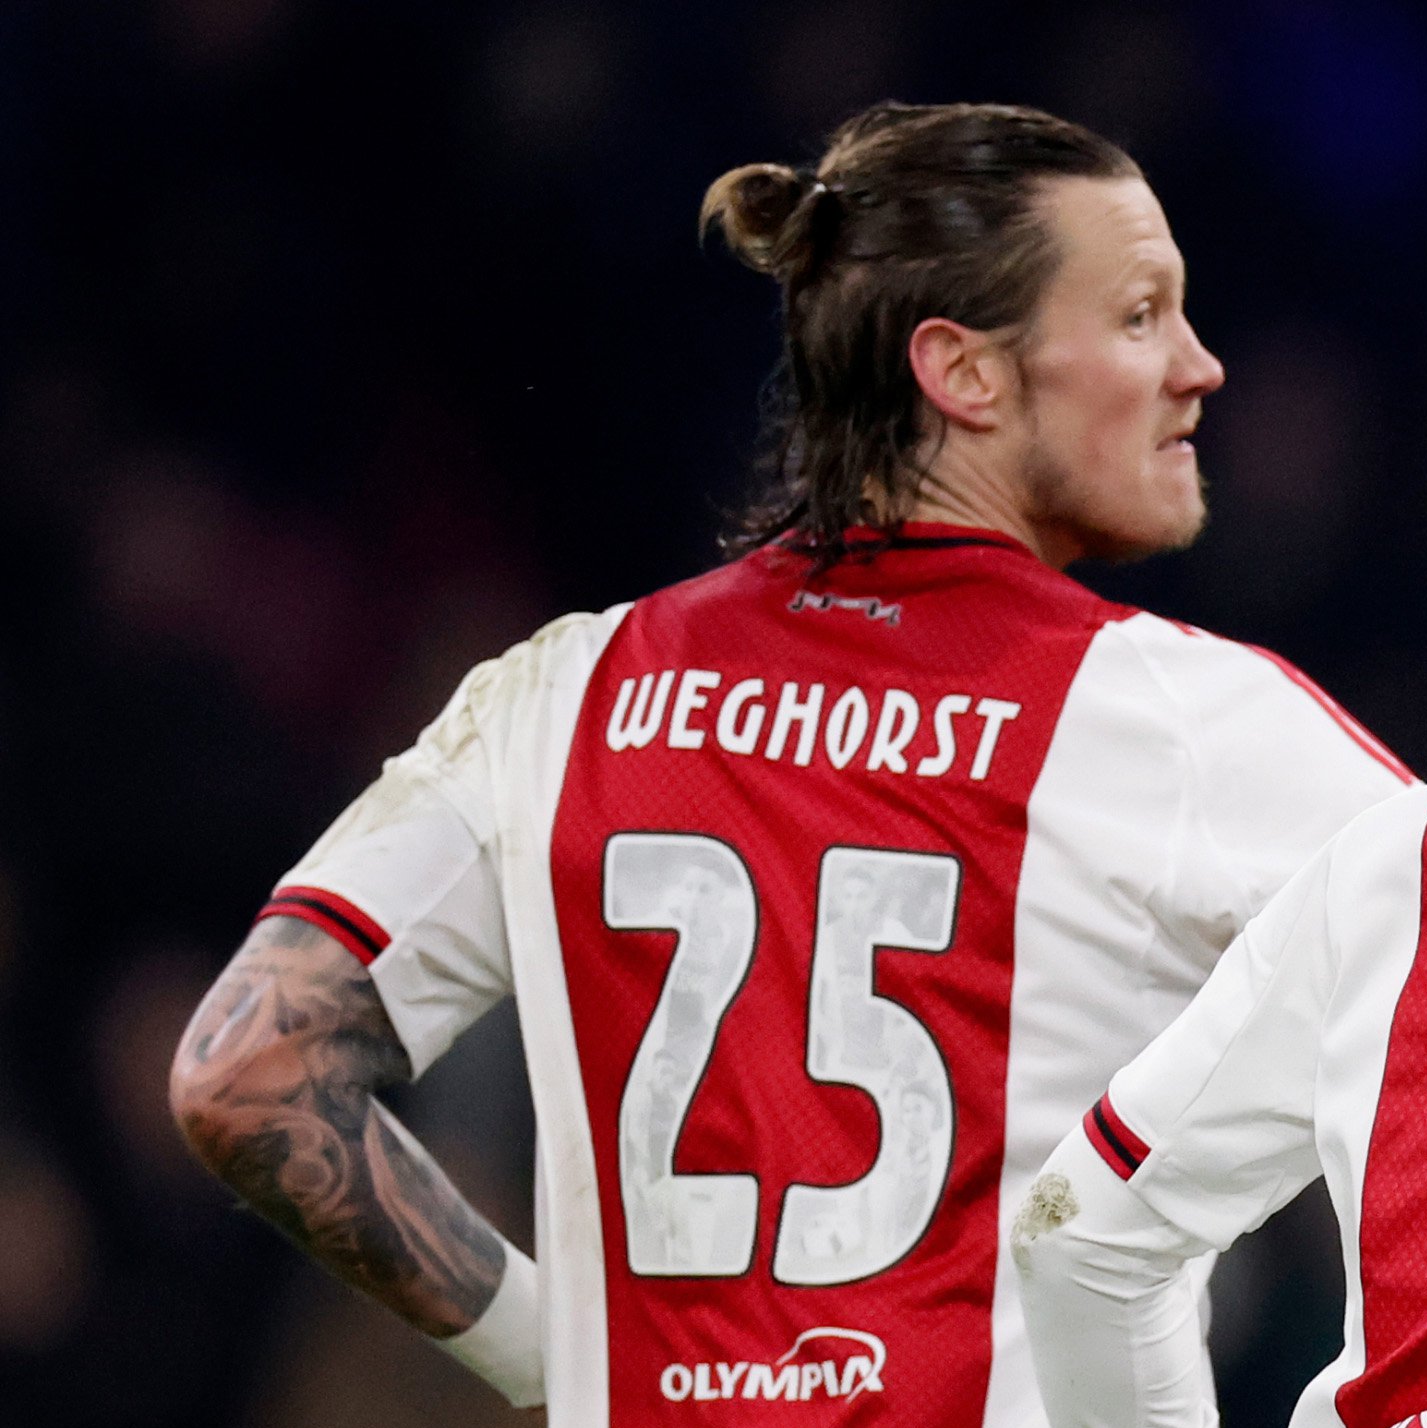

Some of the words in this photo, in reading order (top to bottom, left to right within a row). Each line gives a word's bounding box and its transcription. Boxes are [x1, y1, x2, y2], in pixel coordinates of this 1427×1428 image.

[604, 669, 1021, 782] WEGHORST
[602, 830, 963, 1287] 25
[659, 1354, 884, 1402] OLYMPIA
